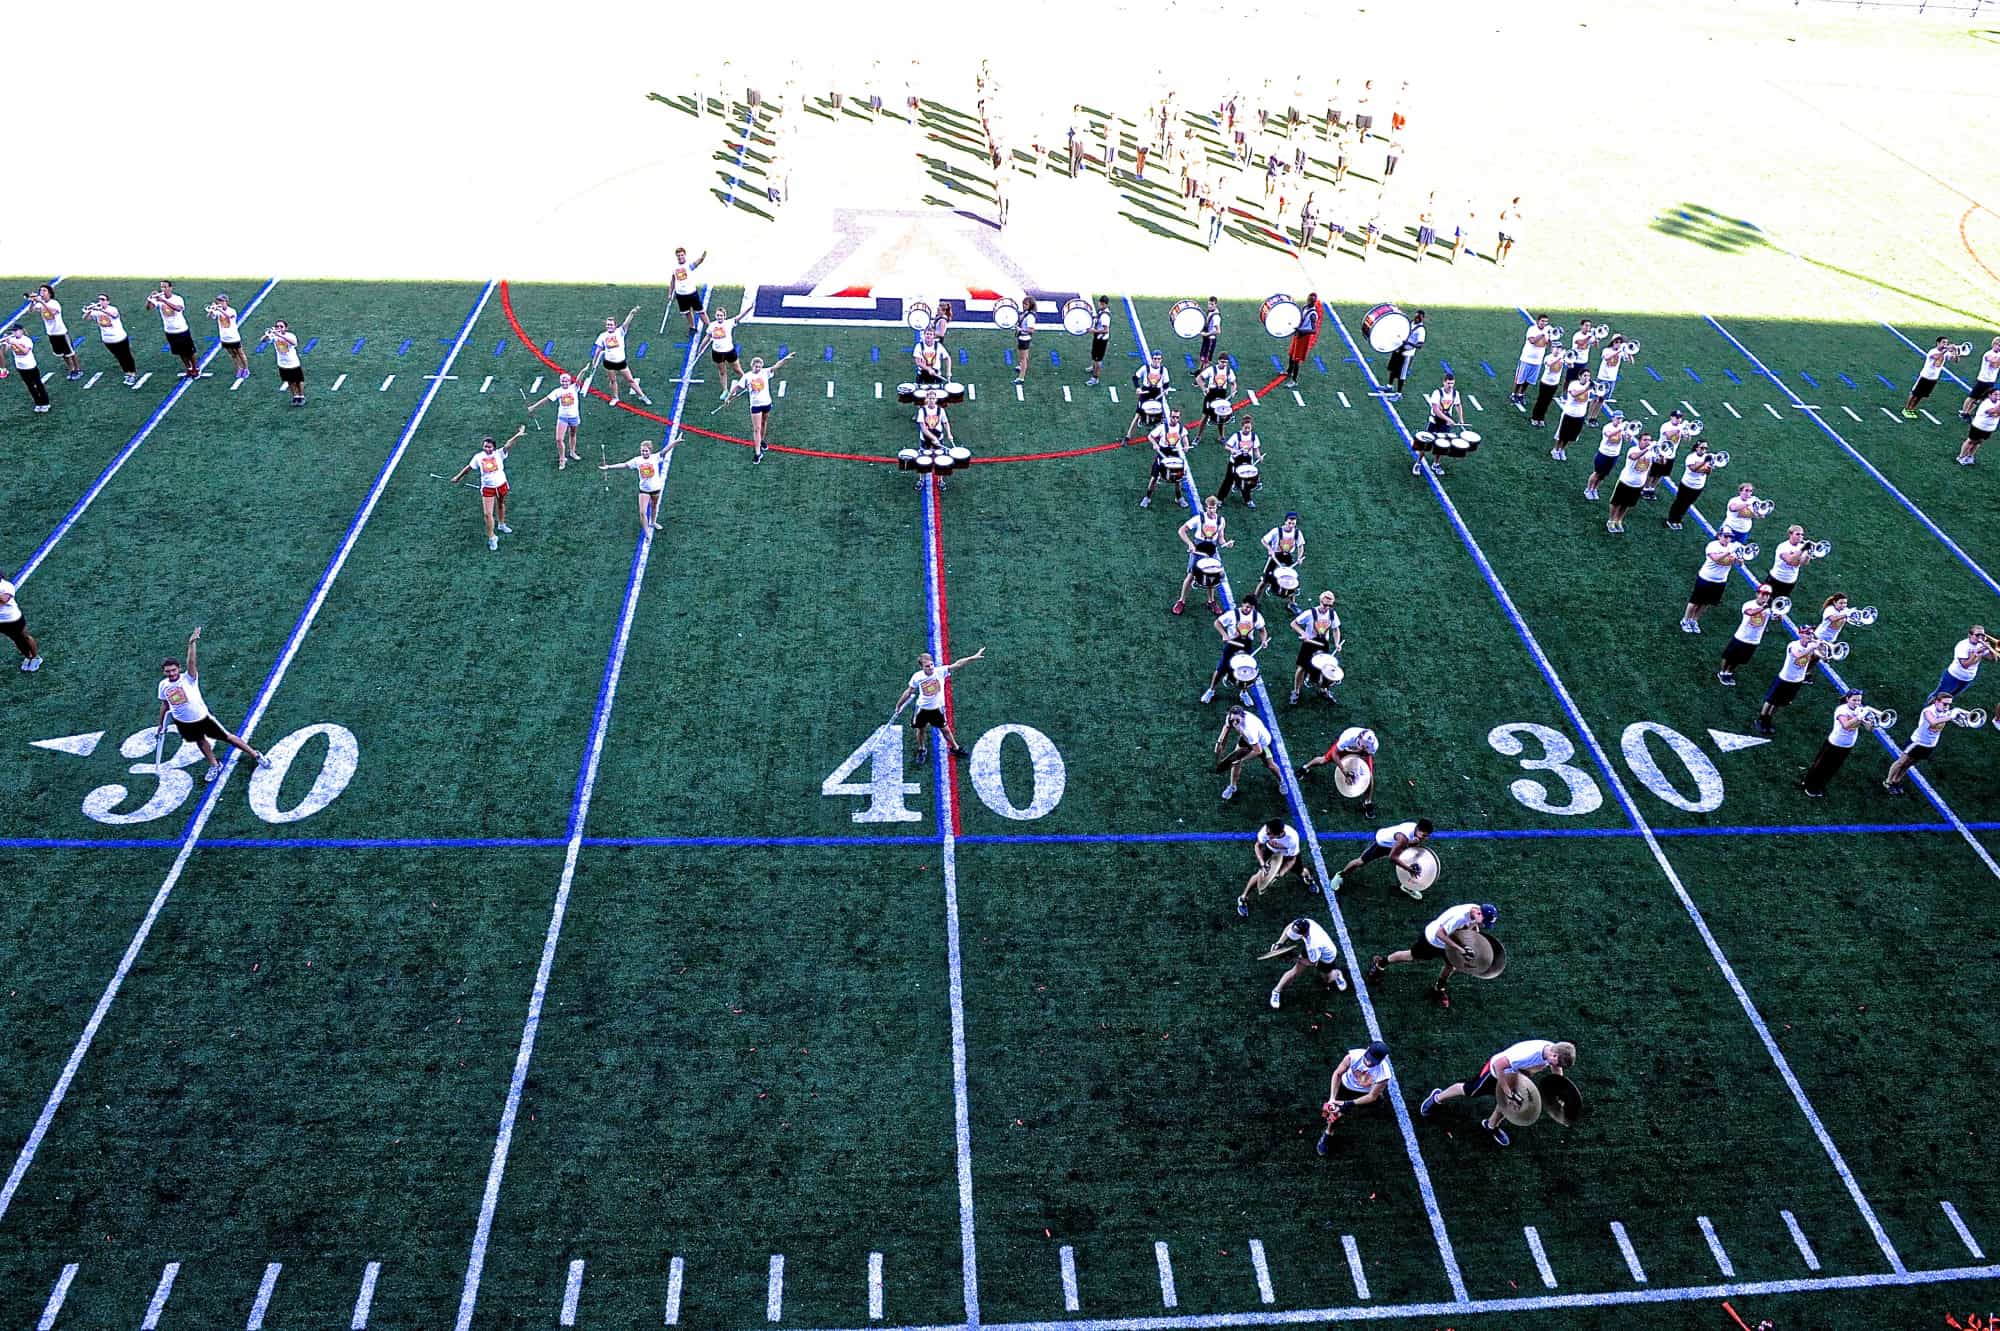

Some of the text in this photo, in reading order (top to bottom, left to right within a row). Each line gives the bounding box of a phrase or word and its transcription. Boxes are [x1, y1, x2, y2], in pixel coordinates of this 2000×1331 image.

[82, 722, 359, 825] 30
[822, 723, 1067, 822] 40
[1487, 721, 1724, 815] 30
